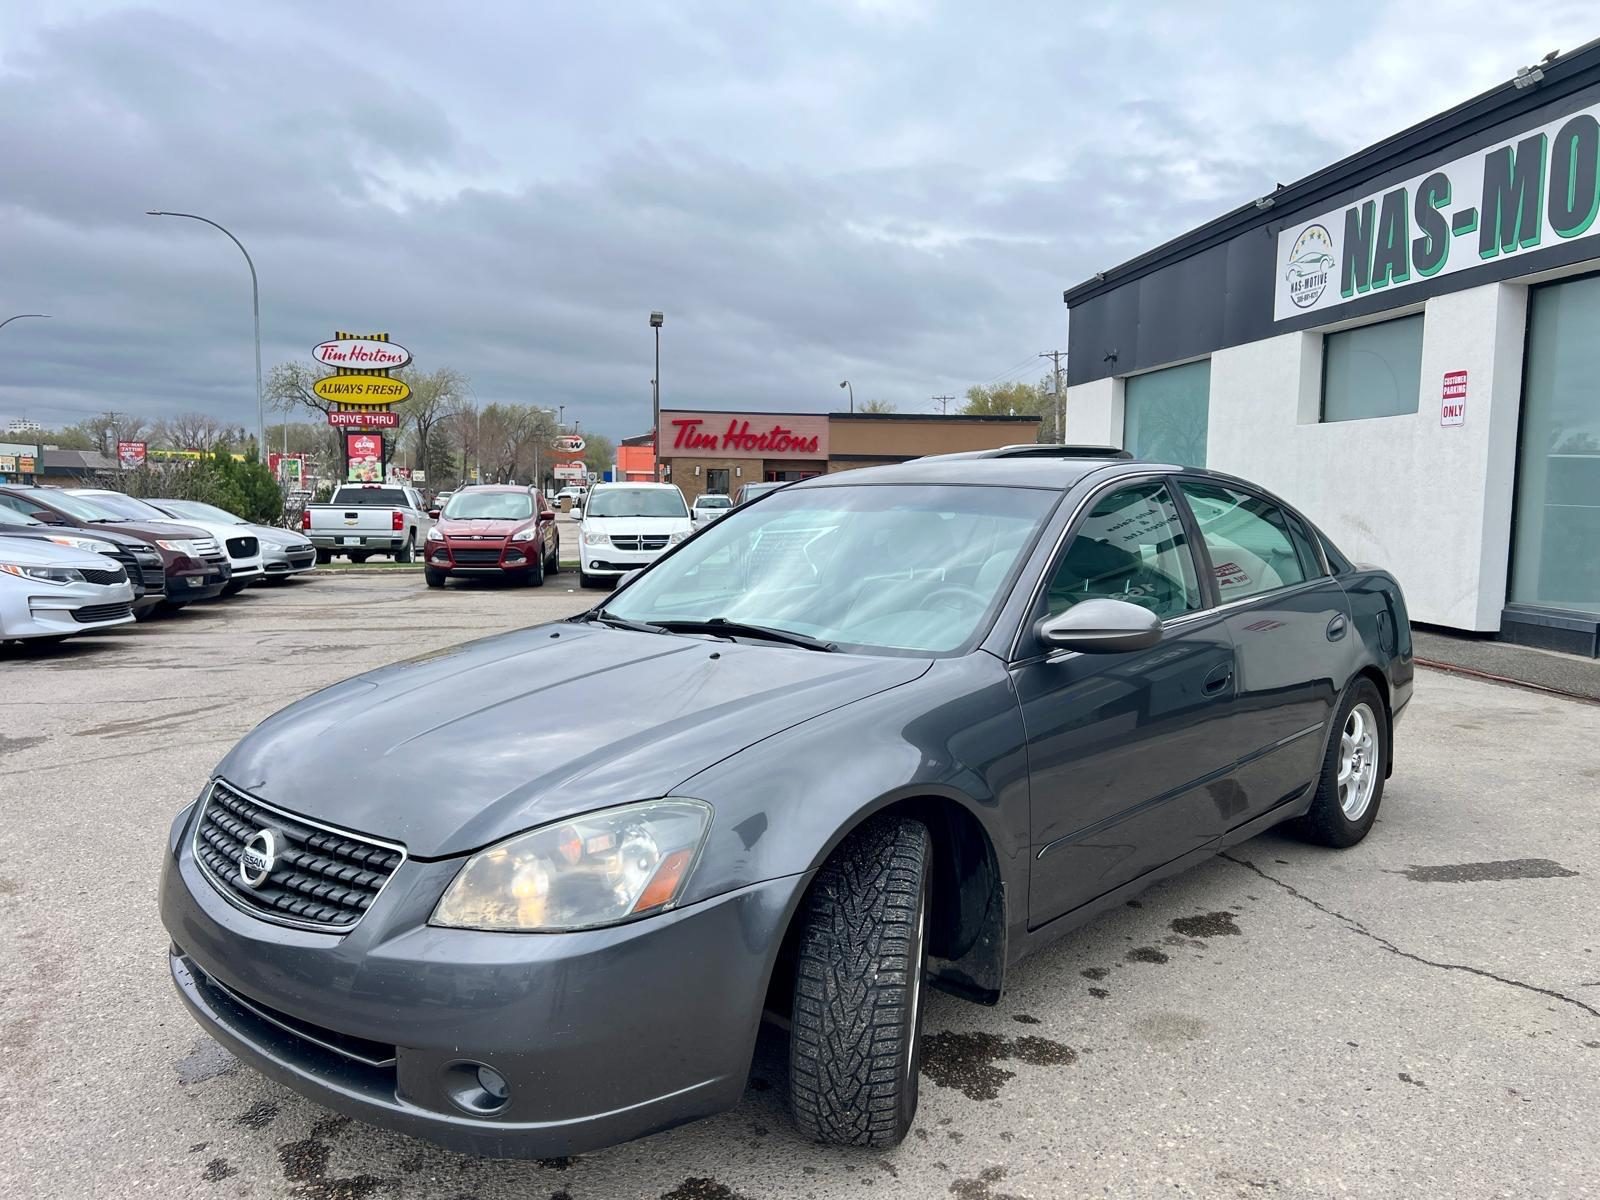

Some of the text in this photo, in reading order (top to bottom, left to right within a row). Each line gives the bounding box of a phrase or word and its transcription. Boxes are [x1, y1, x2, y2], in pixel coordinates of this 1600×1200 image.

[1290, 272, 1328, 293] NAS-MOTIVE
[320, 345, 403, 363] Tim Hortons
[1444, 376, 1467, 386] CUSTOMER
[319, 383, 404, 395] ALWAYS FRESH
[1443, 384, 1466, 395] PARKING
[1443, 404, 1463, 418] ONLY
[331, 414, 394, 425] DRIVE THRU
[672, 419, 818, 453] Tim Hortons
